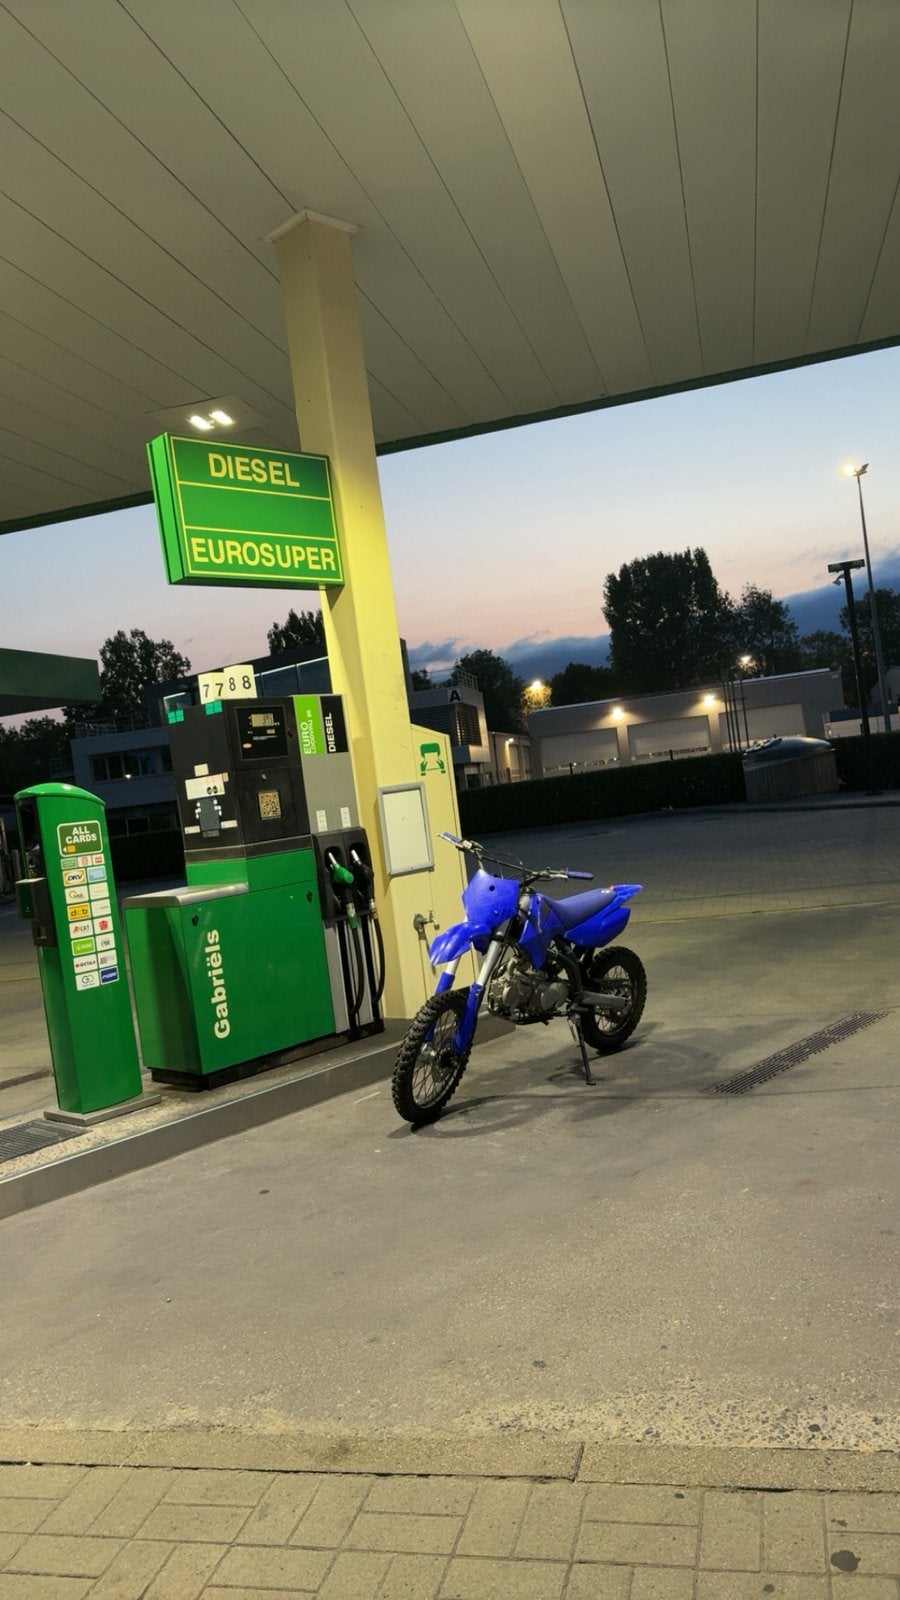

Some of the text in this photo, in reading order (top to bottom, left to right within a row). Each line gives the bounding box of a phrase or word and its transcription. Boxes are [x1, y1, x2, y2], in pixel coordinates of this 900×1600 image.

[208, 453, 300, 487] DIESEL
[191, 537, 336, 571] EUROSUPER
[449, 689, 461, 704] A
[301, 721, 312, 755] EURO
[326, 712, 336, 753] DIESEL
[65, 833, 97, 844] CARDS
[72, 825, 90, 835] ALL
[204, 929, 231, 1039] Gabriëls
